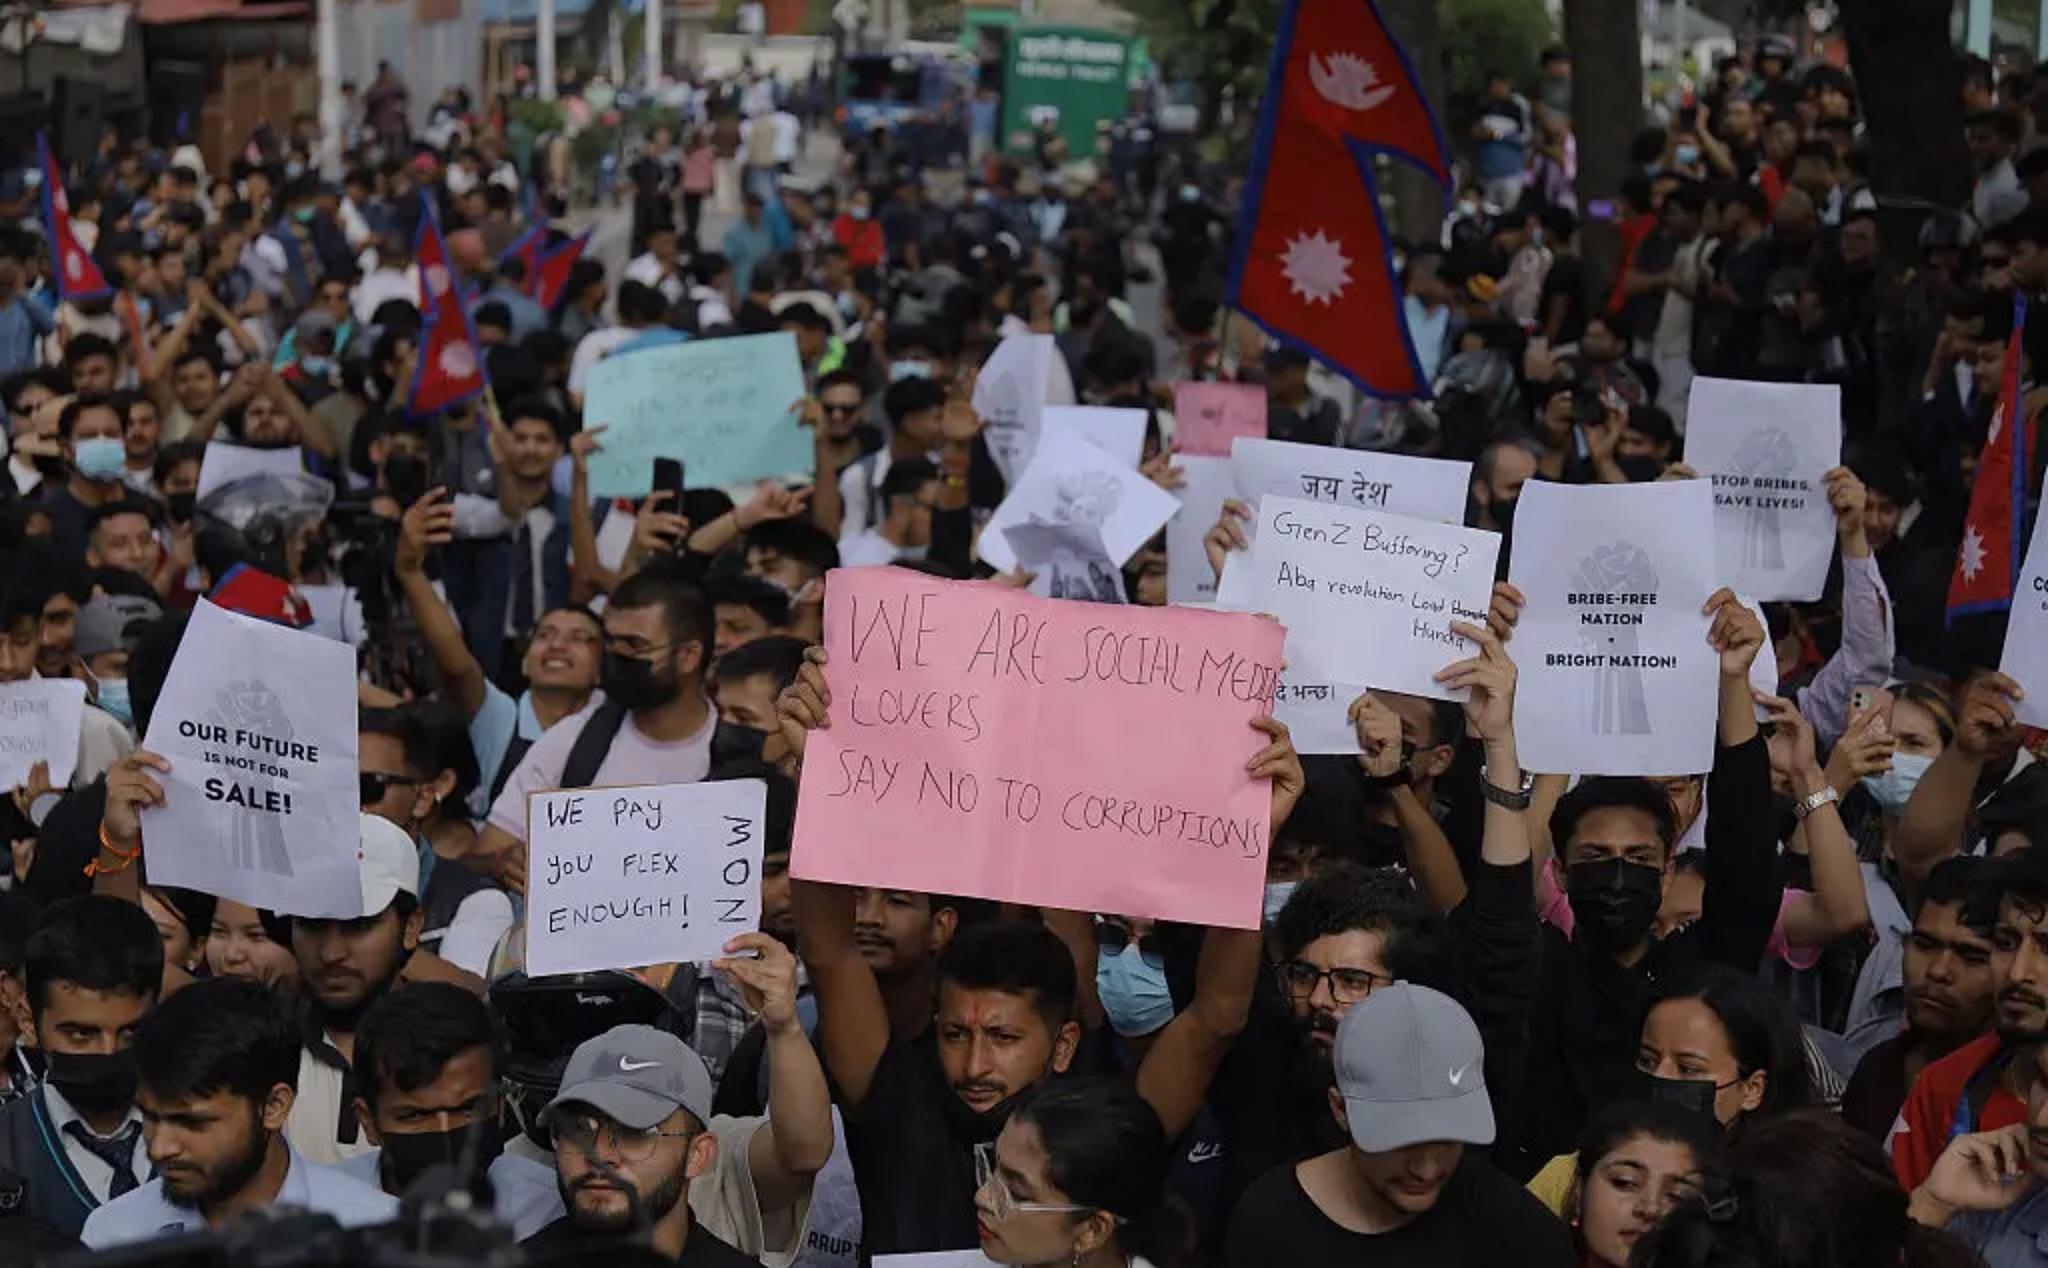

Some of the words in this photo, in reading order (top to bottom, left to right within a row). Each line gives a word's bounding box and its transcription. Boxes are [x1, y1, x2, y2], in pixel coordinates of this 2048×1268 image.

[1301, 474, 1343, 500] जय
[1351, 471, 1392, 506] देश
[1714, 494, 1752, 507] SAVE
[1757, 497, 1805, 509] LIVES!
[1277, 561, 1316, 593] Aba
[1327, 580, 1405, 603] revolution
[1567, 593, 1658, 605] BRIBE-FREE
[1581, 613, 1643, 625] NATION
[850, 593, 940, 671] WE
[967, 607, 1049, 685] ARE
[1065, 625, 1184, 693] SOCIAL
[1545, 653, 1605, 667] BRIGHT
[1609, 655, 1677, 668] NATION!
[850, 685, 982, 742] LOVERS
[179, 720, 227, 744] OUR
[236, 730, 319, 763] FUTURE
[204, 751, 220, 764] IS
[225, 755, 256, 771] NOT
[259, 763, 289, 779] FOR
[205, 778, 292, 815] SALE!
[547, 797, 584, 828] WE
[828, 748, 901, 801] SAY
[919, 762, 979, 813] NO
[995, 776, 1041, 822] TO
[1061, 791, 1261, 858] CORRUPTIONS
[622, 852, 679, 877] FLEX
[549, 894, 690, 933] ENOUGH!
